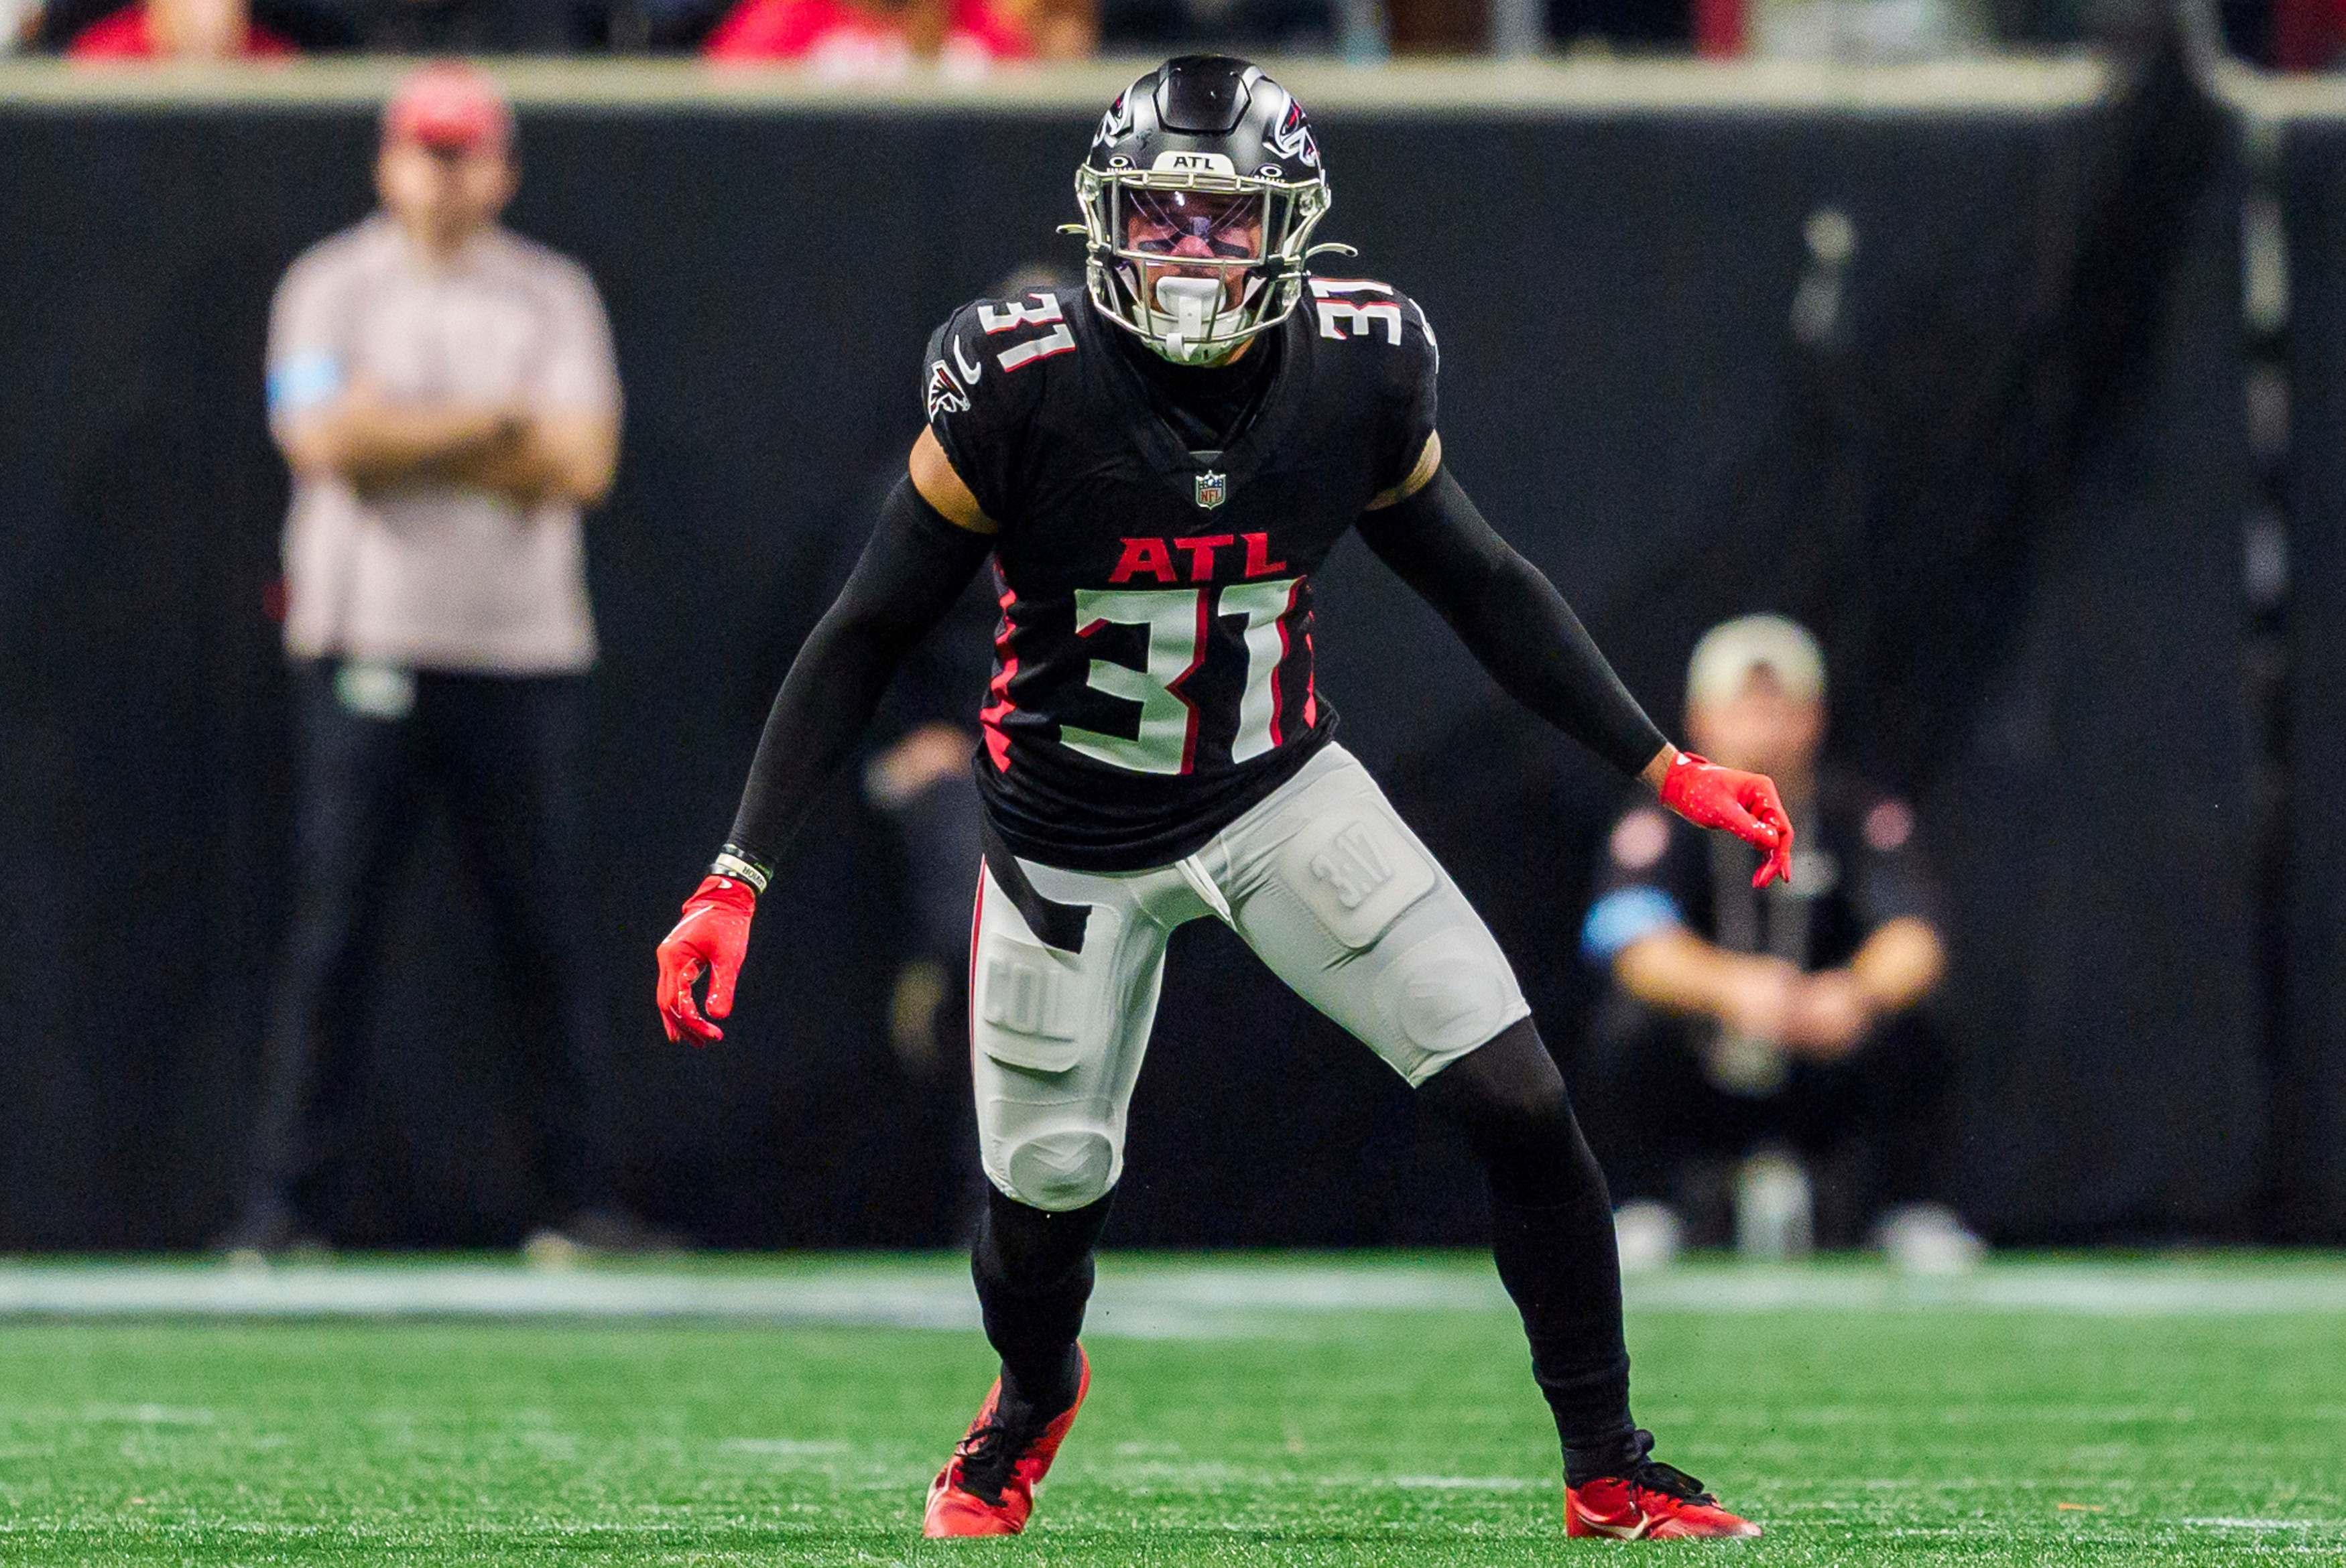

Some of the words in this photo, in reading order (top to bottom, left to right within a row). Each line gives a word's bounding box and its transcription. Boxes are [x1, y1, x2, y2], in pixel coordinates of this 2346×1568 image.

[1174, 156, 1214, 170] ATL
[977, 293, 1076, 373] 31
[1308, 277, 1402, 346] 31
[1200, 489, 1222, 503] NFL
[1109, 533, 1286, 582] ATL
[1060, 575, 1306, 775] 31
